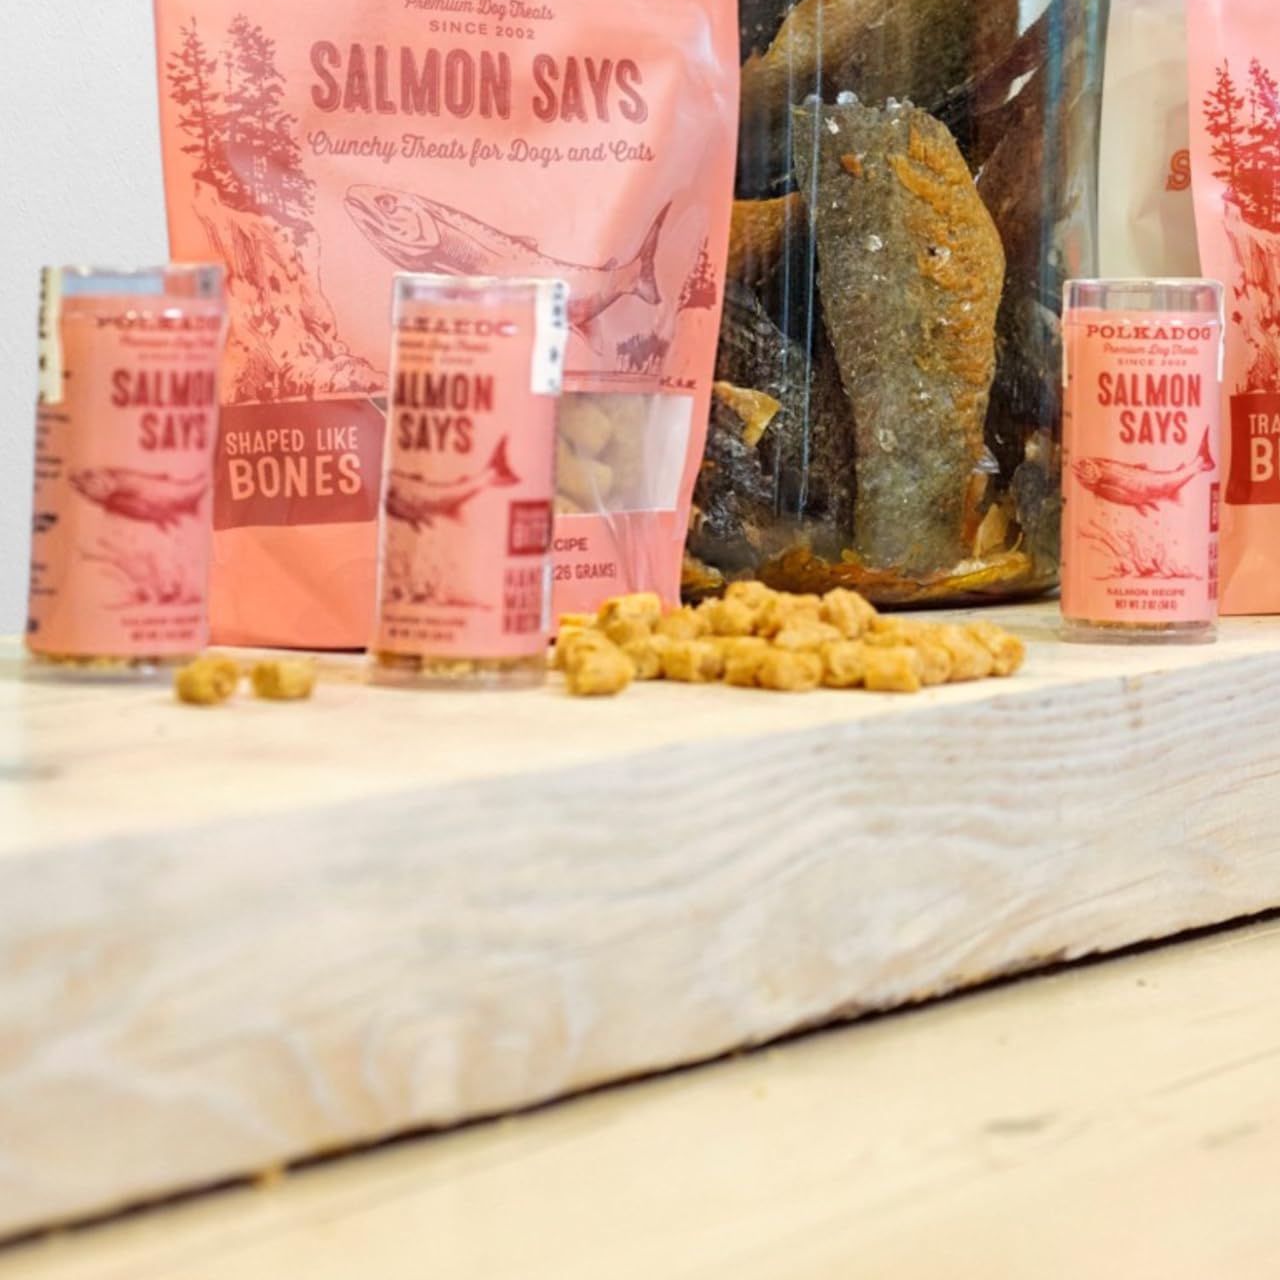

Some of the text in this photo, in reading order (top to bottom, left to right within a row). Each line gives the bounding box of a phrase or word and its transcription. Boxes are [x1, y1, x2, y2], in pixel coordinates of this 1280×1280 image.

[509, 0, 555, 21] Treats
[429, 20, 536, 41] SINCE 2002
[309, 39, 649, 125] SALMON SAYS
[306, 130, 655, 168] Crunchy Treats for Dogs and Cats
[1086, 324, 1212, 340] POLKADOG
[393, 372, 494, 411] ALMON
[1097, 371, 1201, 407] SALMON
[225, 426, 359, 456] SHAPED LIKE
[397, 412, 474, 454] SAYS
[1119, 410, 1188, 444] SAYS
[228, 452, 362, 501] BONES
[554, 537, 588, 552] CIPE
